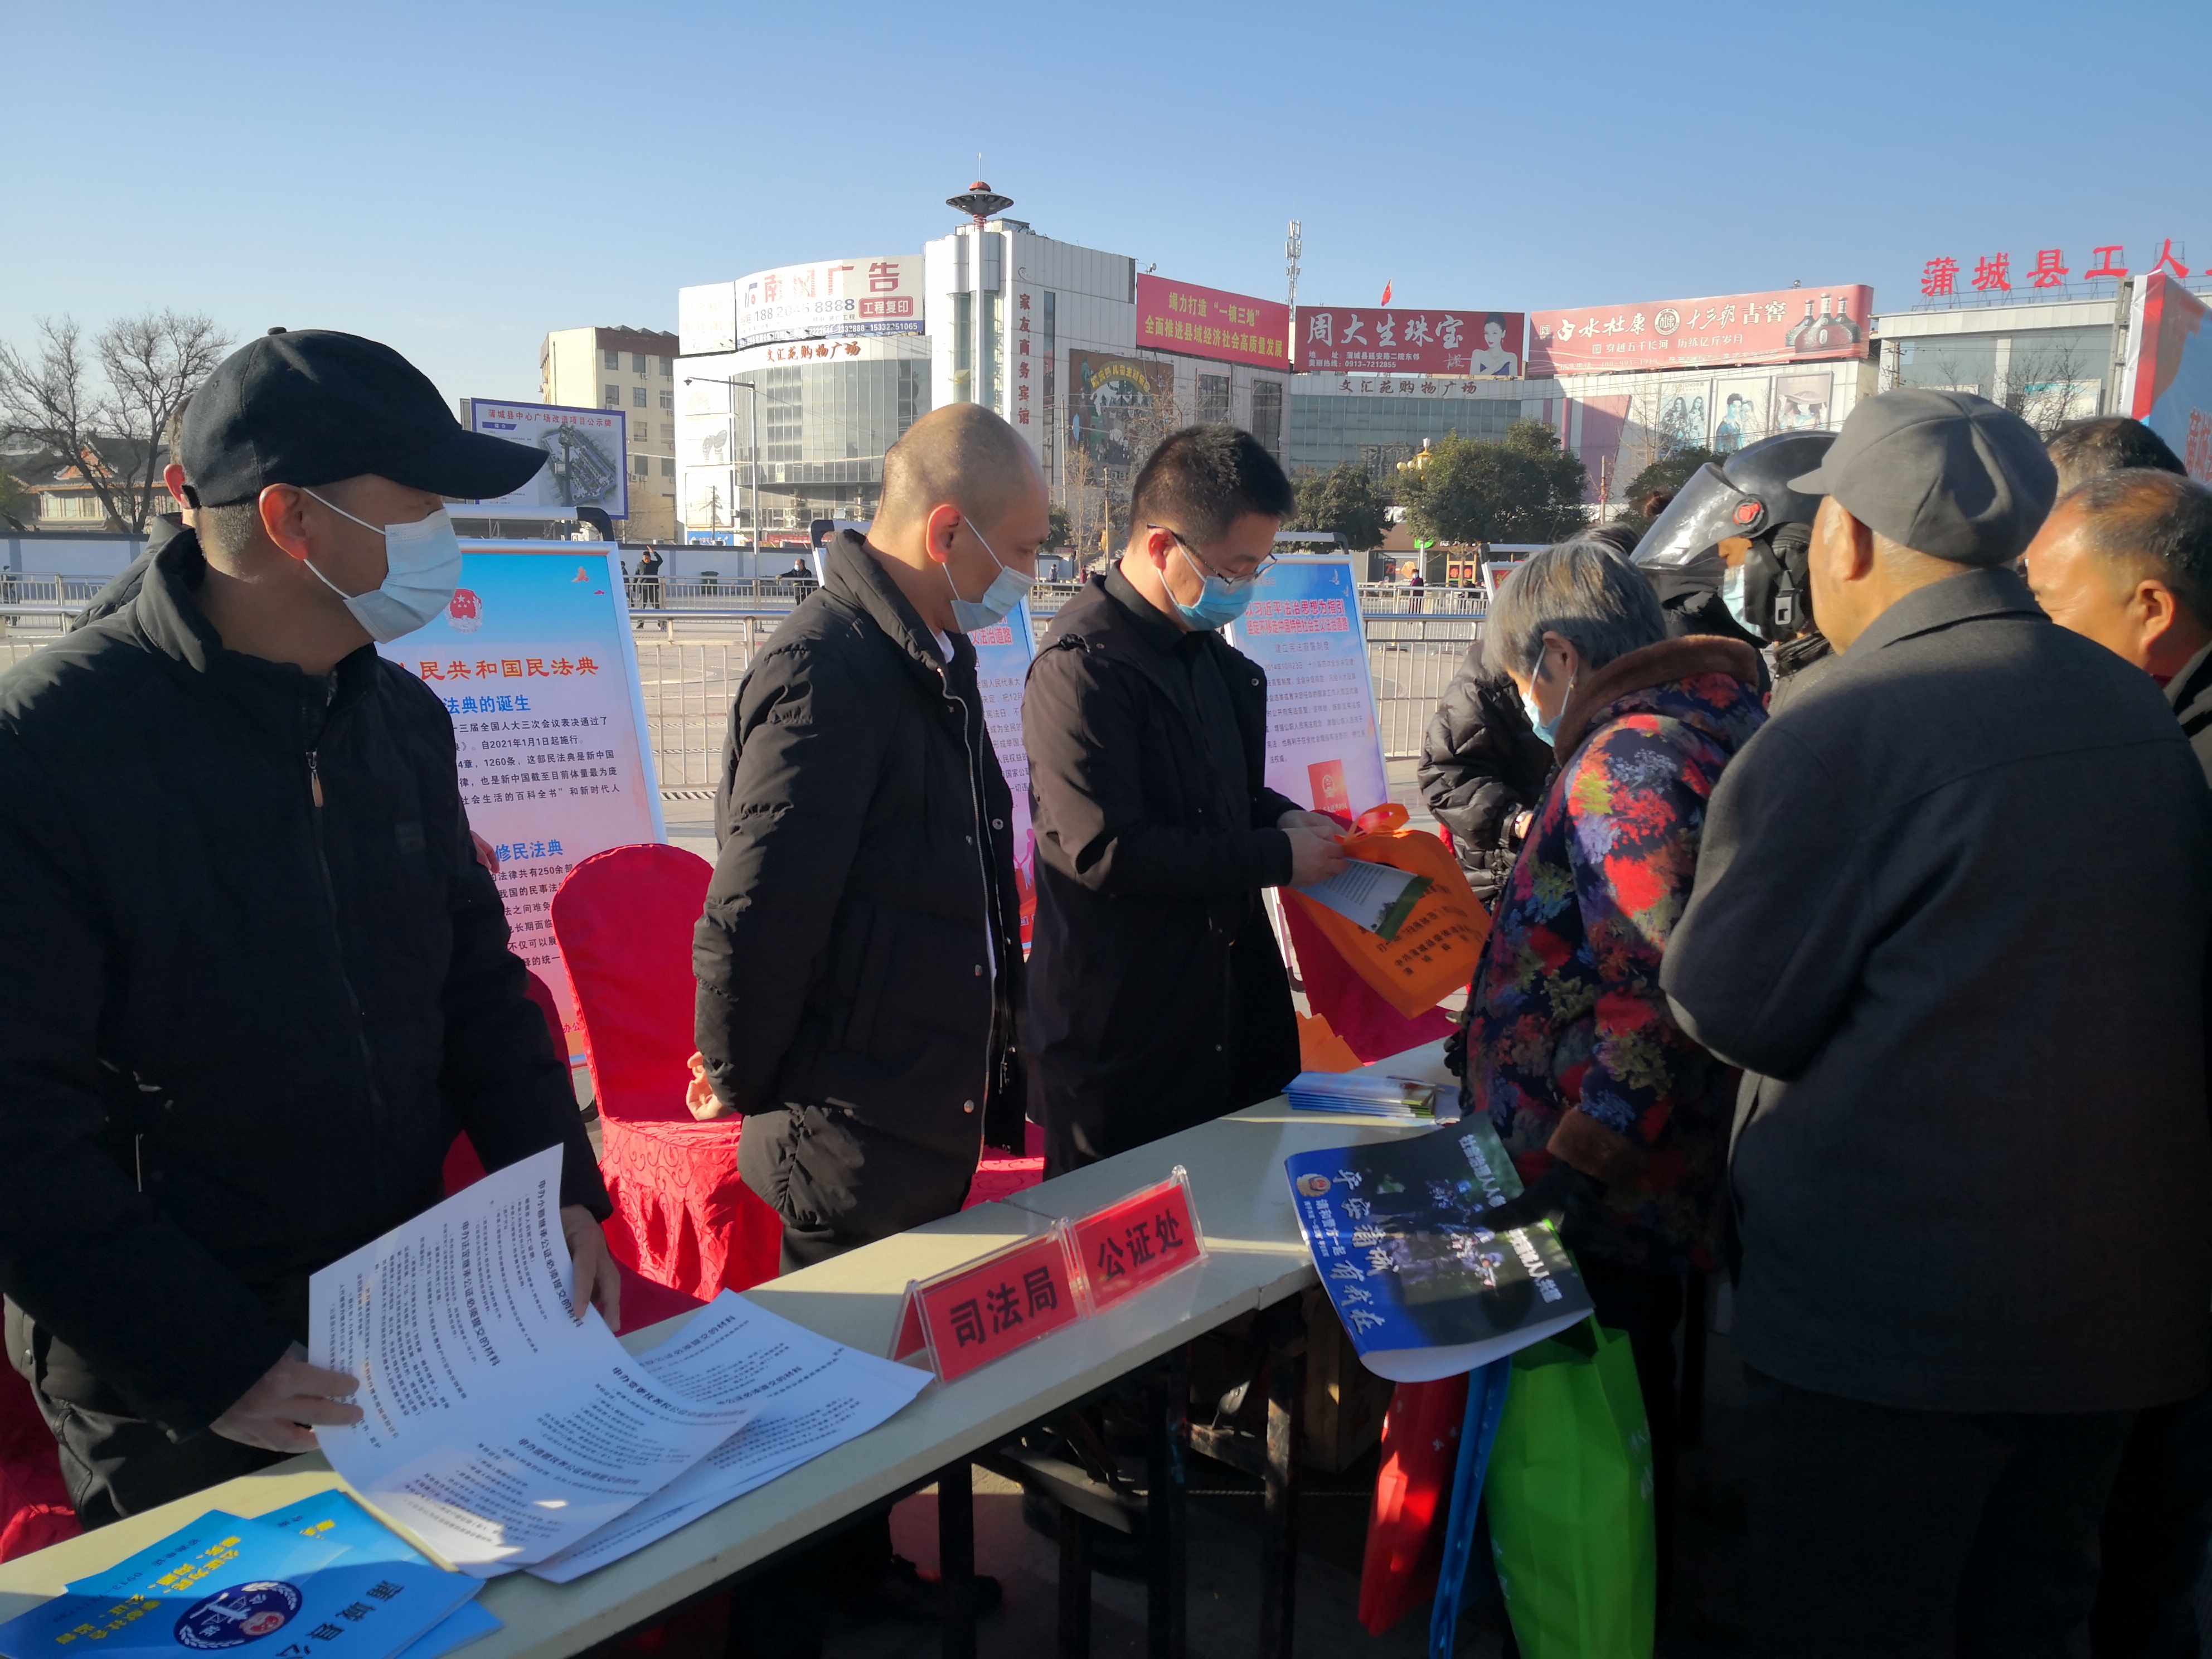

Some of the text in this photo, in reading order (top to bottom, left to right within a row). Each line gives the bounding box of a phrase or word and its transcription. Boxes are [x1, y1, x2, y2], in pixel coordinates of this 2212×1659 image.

[1920, 238, 2212, 297] 蒲城县工人
[862, 299, 909, 315] 工程复印
[1169, 292, 1260, 327] 竭力打造“一镇三地”
[1144, 314, 1283, 358] 全面推进县域经济社会高质量发展
[1307, 312, 1464, 350] 周大生珠宝
[1557, 313, 1646, 342] 白水杜康
[766, 341, 861, 363] 文汇苑购物广场
[1605, 333, 1744, 355] 穿越五千长河 历练亿斤岁月
[1338, 379, 1477, 396] 文汇苑购物广场
[488, 409, 613, 428] 蒲城县中心广场改造项目公示牌
[1244, 598, 1346, 617] 以习近平法治思想为指引
[1246, 616, 1349, 636] 坚定不移走中国特色社会主义法治道路
[444, 694, 532, 716] 法典的诞生
[452, 715, 609, 734] 三届全国人大三次会议表决通过了
[986, 722, 1023, 734] 成为全民的
[494, 838, 564, 863] 修民法典
[498, 881, 564, 900] 我国的民事法
[1313, 1197, 1347, 1259] 请和警方一起
[1332, 1168, 1393, 1277] 平安蒲城
[1097, 1209, 1183, 1281] 公证处
[460, 1220, 502, 1369] 申办法定继承公证必须提交的材料
[949, 1265, 1058, 1348] 司法局
[1328, 1259, 1386, 1336] 有我在
